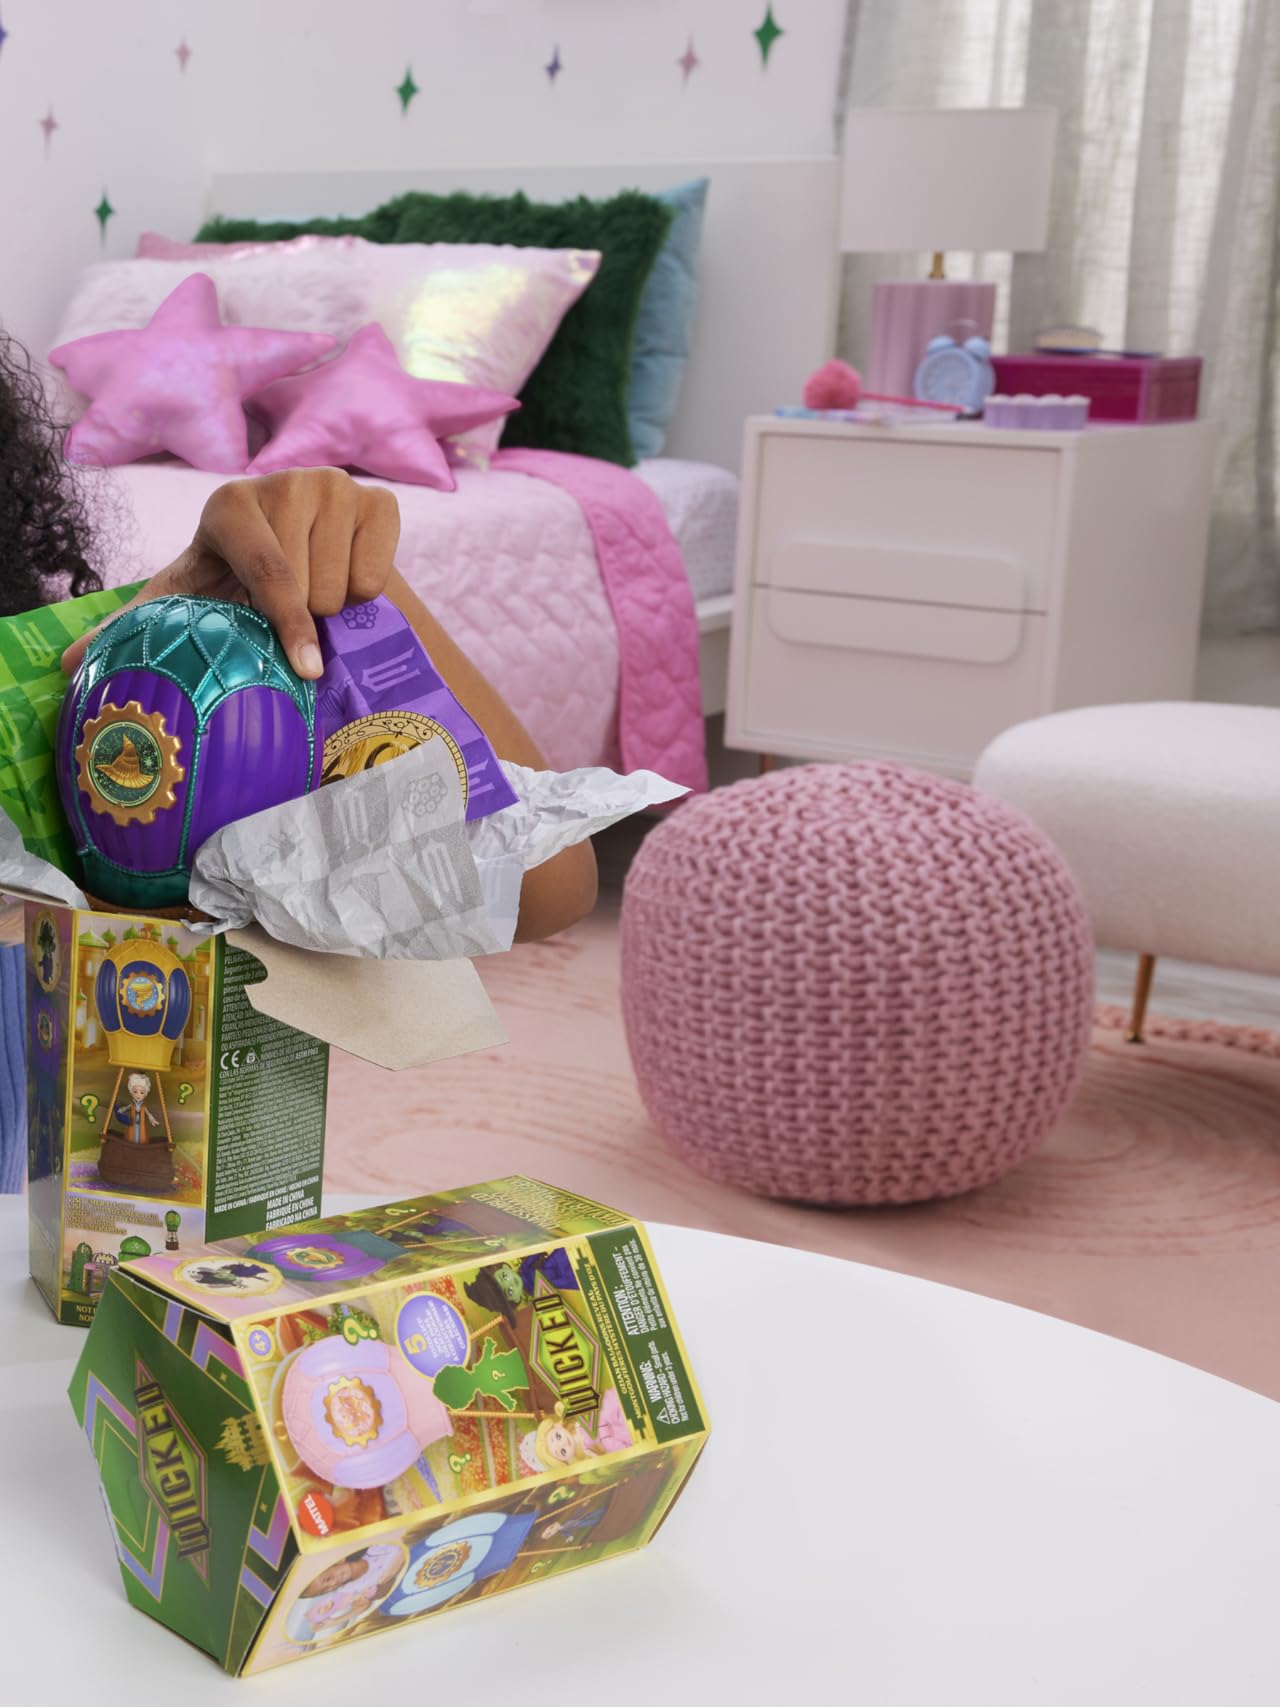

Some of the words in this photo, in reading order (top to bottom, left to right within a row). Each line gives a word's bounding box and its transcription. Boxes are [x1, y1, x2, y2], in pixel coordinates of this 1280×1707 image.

[215, 1204, 227, 1213] MADE
[233, 1199, 246, 1208] CHINA
[275, 1186, 286, 1195] CHINE
[289, 1182, 301, 1190] HECHO
[308, 1176, 319, 1184] CHINA
[267, 1197, 281, 1209] MADE
[289, 1190, 304, 1202] CHINA
[299, 1197, 313, 1209] CHINE
[266, 1215, 294, 1231] FABRICADO
[302, 1207, 317, 1219] CHINA
[627, 1256, 639, 1279] convient
[642, 1271, 651, 1287] moins
[591, 1281, 602, 1301] PAYS
[588, 1290, 603, 1322] REVEAL
[614, 1290, 639, 1335] ATTENTION
[650, 1297, 662, 1317] enfants
[633, 1306, 649, 1333] DANGER
[648, 1314, 657, 1331] Petits
[404, 1333, 428, 1355] 5
[533, 1293, 600, 1418] WICKED
[600, 1323, 618, 1367] BALLOONS
[652, 1355, 662, 1368] Small
[615, 1368, 627, 1394] OZIAN
[640, 1361, 661, 1402] WARNING:
[657, 1374, 671, 1397] HAZARD
[668, 1371, 677, 1385] under
[673, 1385, 683, 1404] children
[665, 1397, 680, 1424] CHOKING
[136, 1380, 211, 1560] WICKED
[305, 1494, 332, 1536] MATTEL
